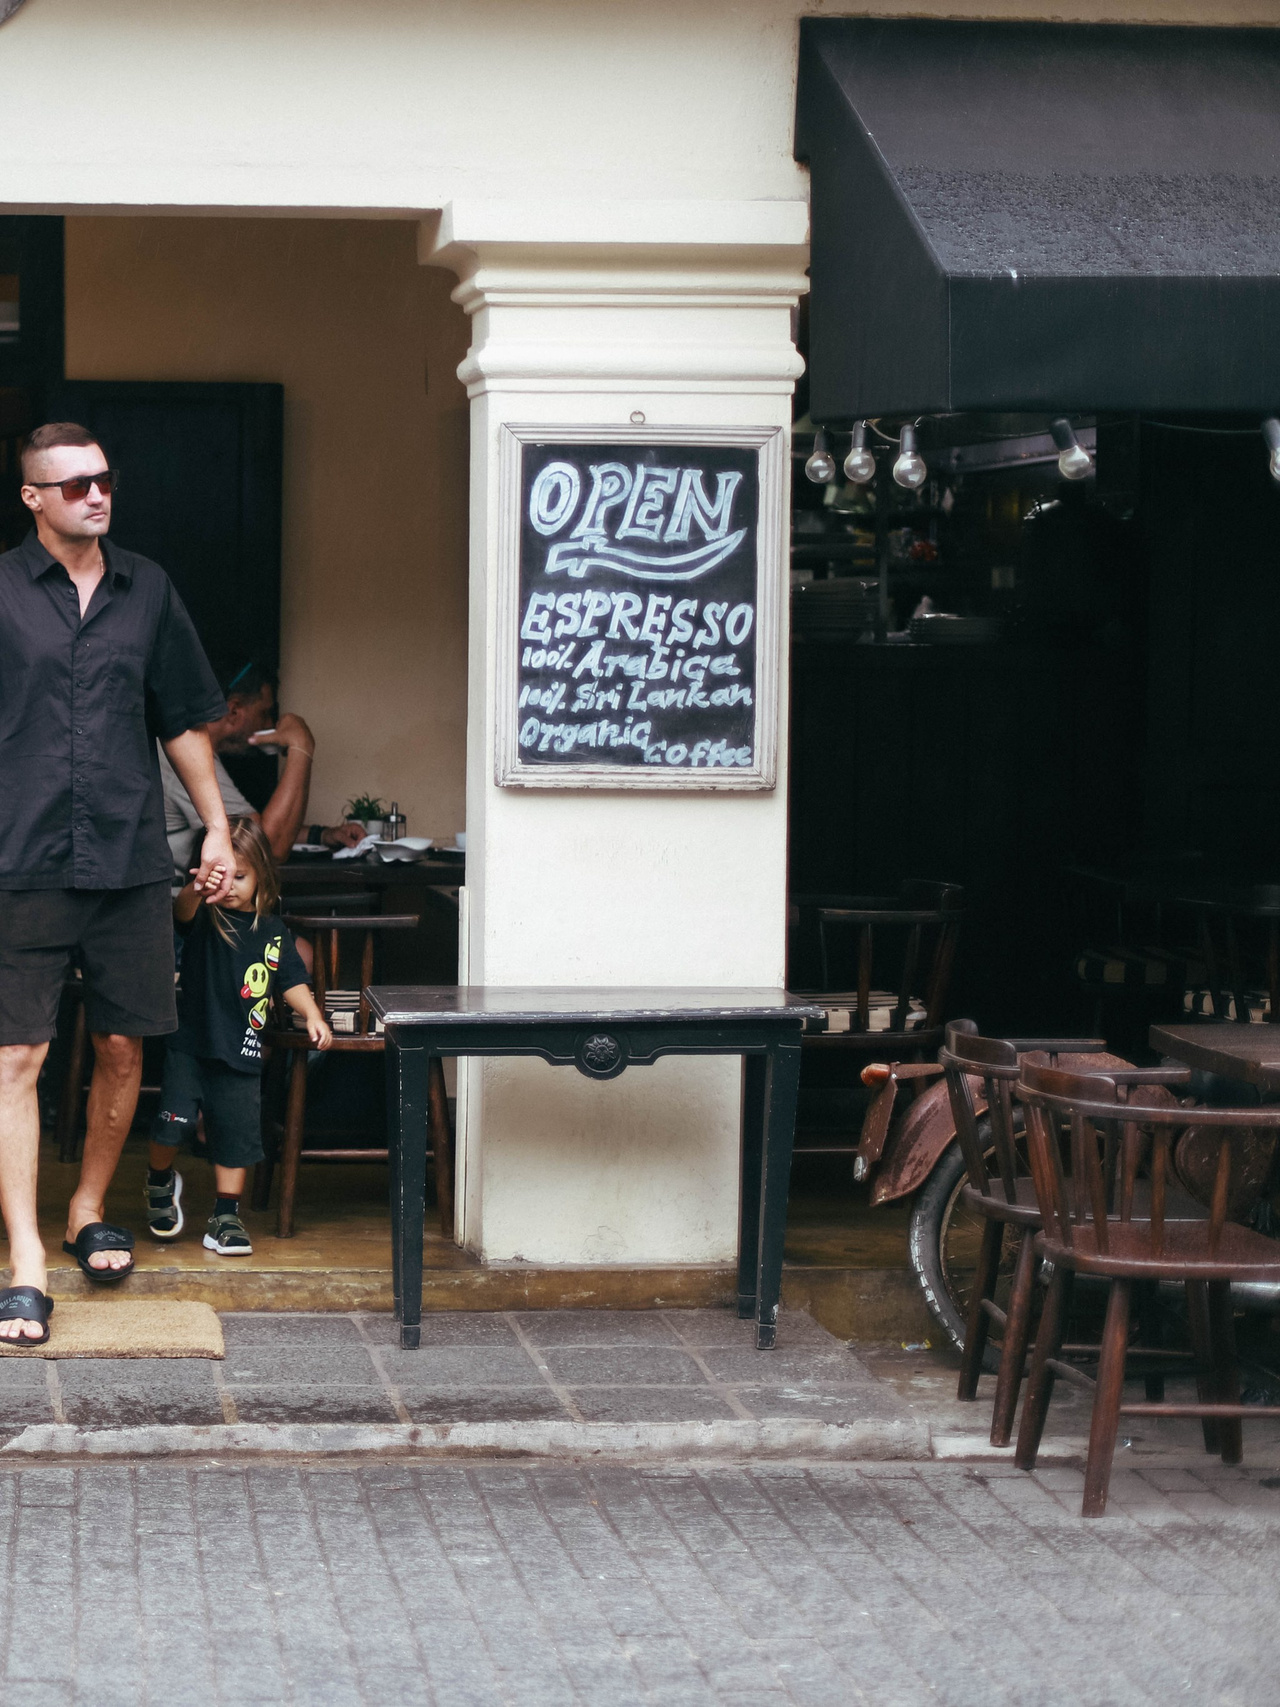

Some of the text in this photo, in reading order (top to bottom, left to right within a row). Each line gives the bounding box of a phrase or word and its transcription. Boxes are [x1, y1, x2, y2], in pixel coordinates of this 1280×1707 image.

[529, 461, 743, 543] OPEN
[520, 588, 754, 650] ESPRESSO
[521, 640, 577, 671] 100%
[518, 680, 753, 715] 100% Sri Lankan
[519, 715, 652, 753] Organic
